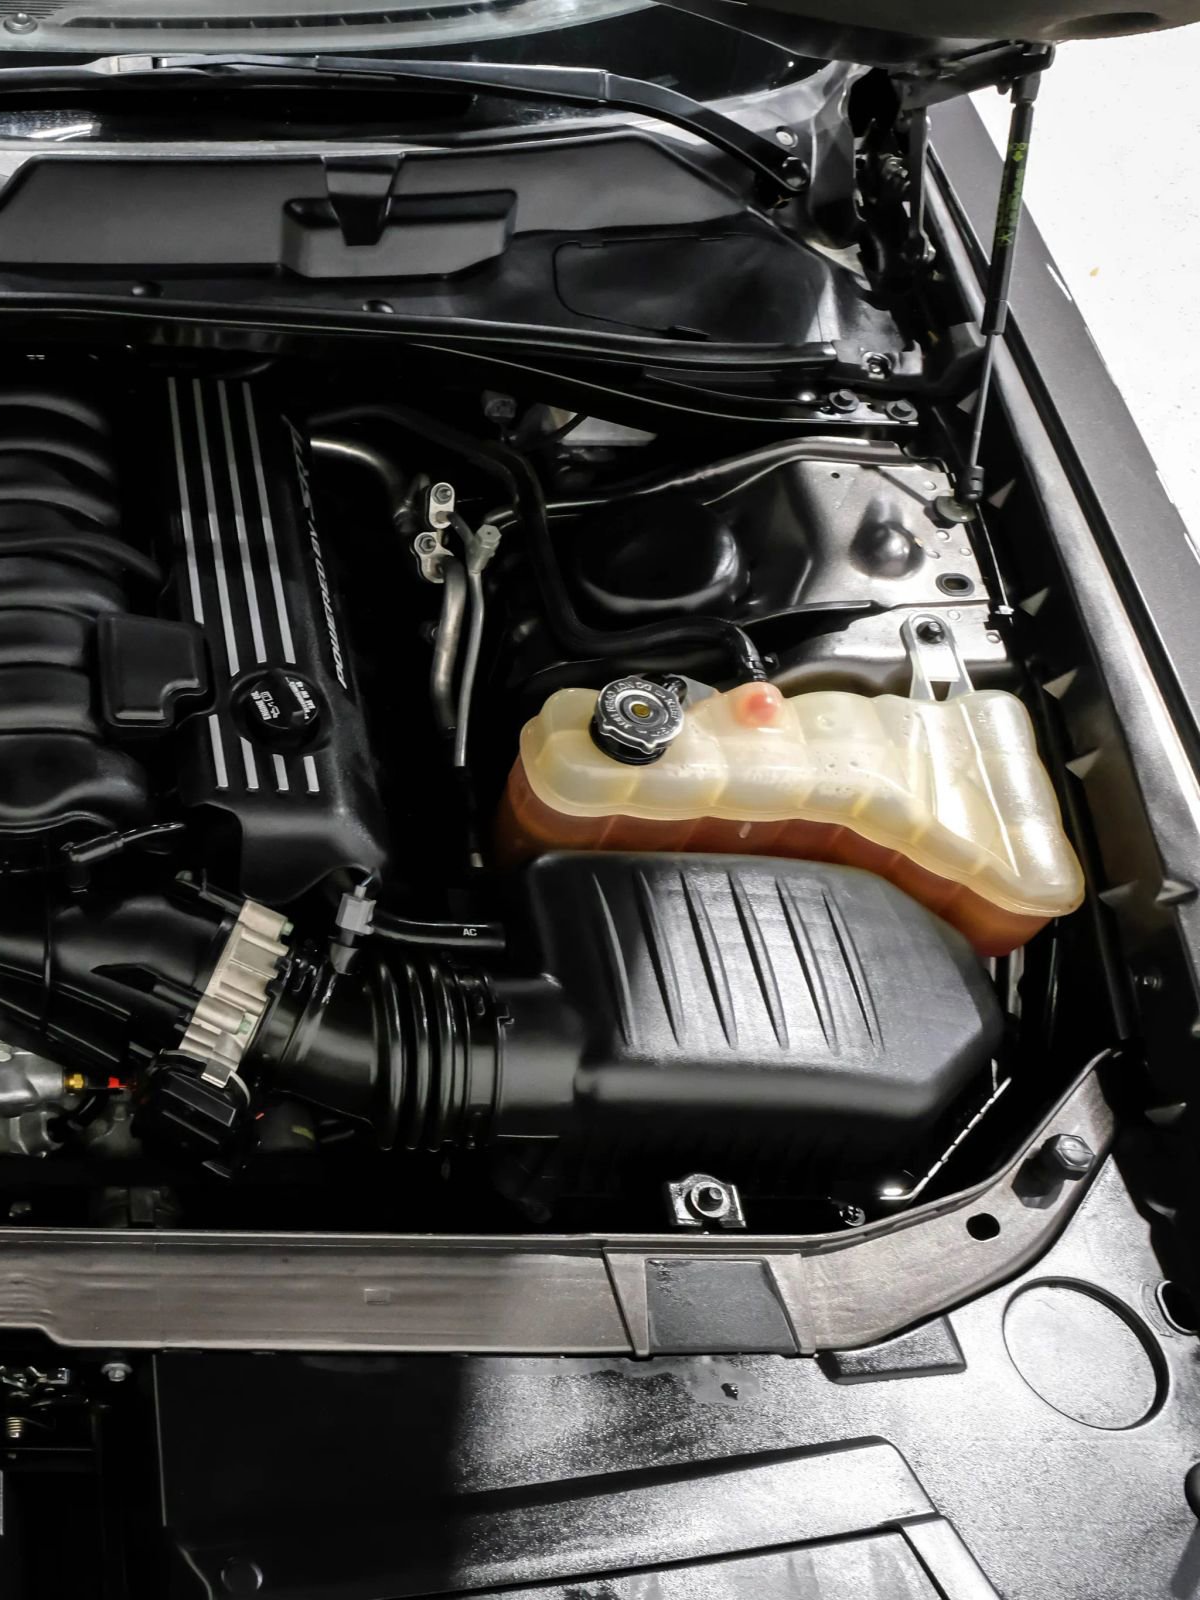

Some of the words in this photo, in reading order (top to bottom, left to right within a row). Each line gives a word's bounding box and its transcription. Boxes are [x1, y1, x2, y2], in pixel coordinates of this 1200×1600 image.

[307, 519, 322, 560] BY
[314, 557, 347, 690] POWERED
[250, 690, 261, 700] OIL
[255, 700, 272, 720] ENGINE
[463, 928, 477, 936] AC
